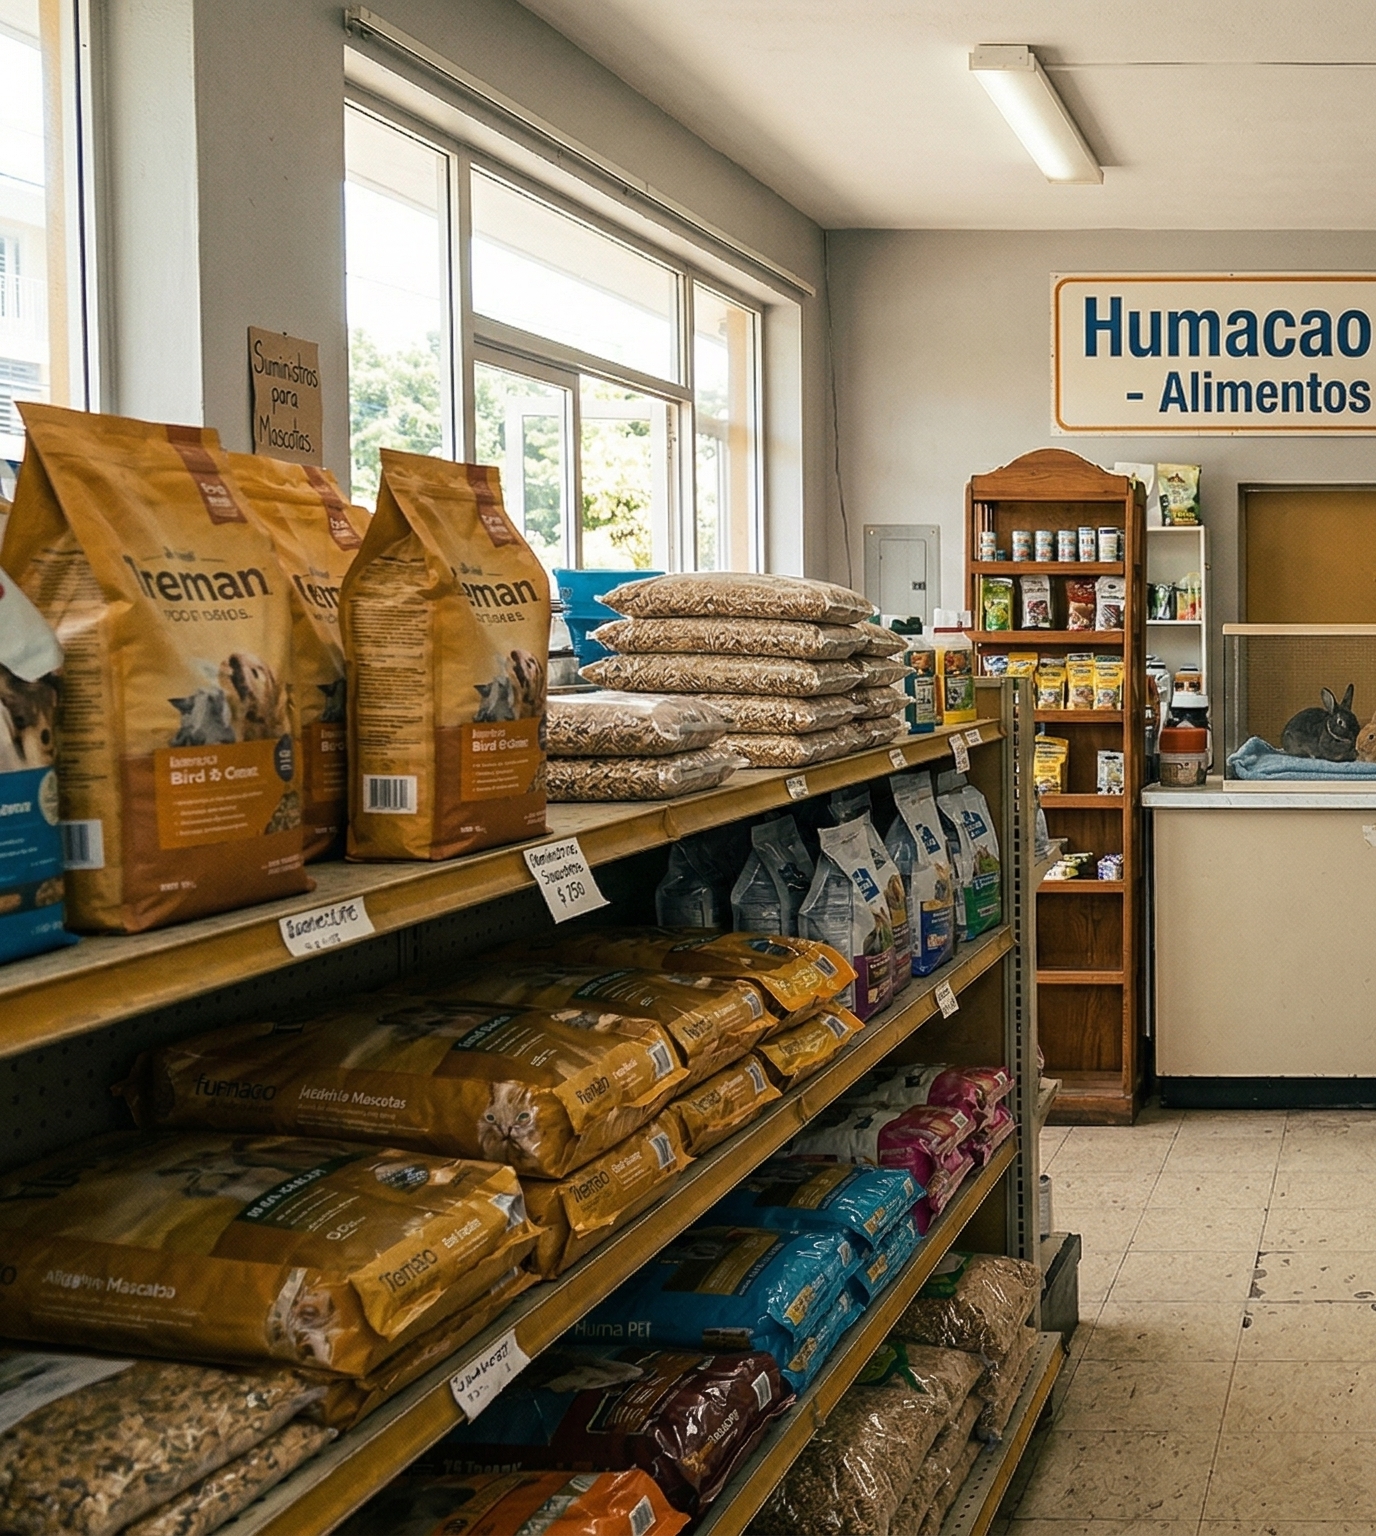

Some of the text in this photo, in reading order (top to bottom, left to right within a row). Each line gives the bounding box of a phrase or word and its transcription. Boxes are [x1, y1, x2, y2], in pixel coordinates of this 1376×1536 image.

[1084, 296, 1372, 358] Humacao
[254, 340, 318, 388] Suministros
[271, 387, 299, 415] para
[1158, 370, 1372, 414] Alimentos
[260, 415, 315, 453] Mascotas.
[171, 769, 206, 785] Bird
